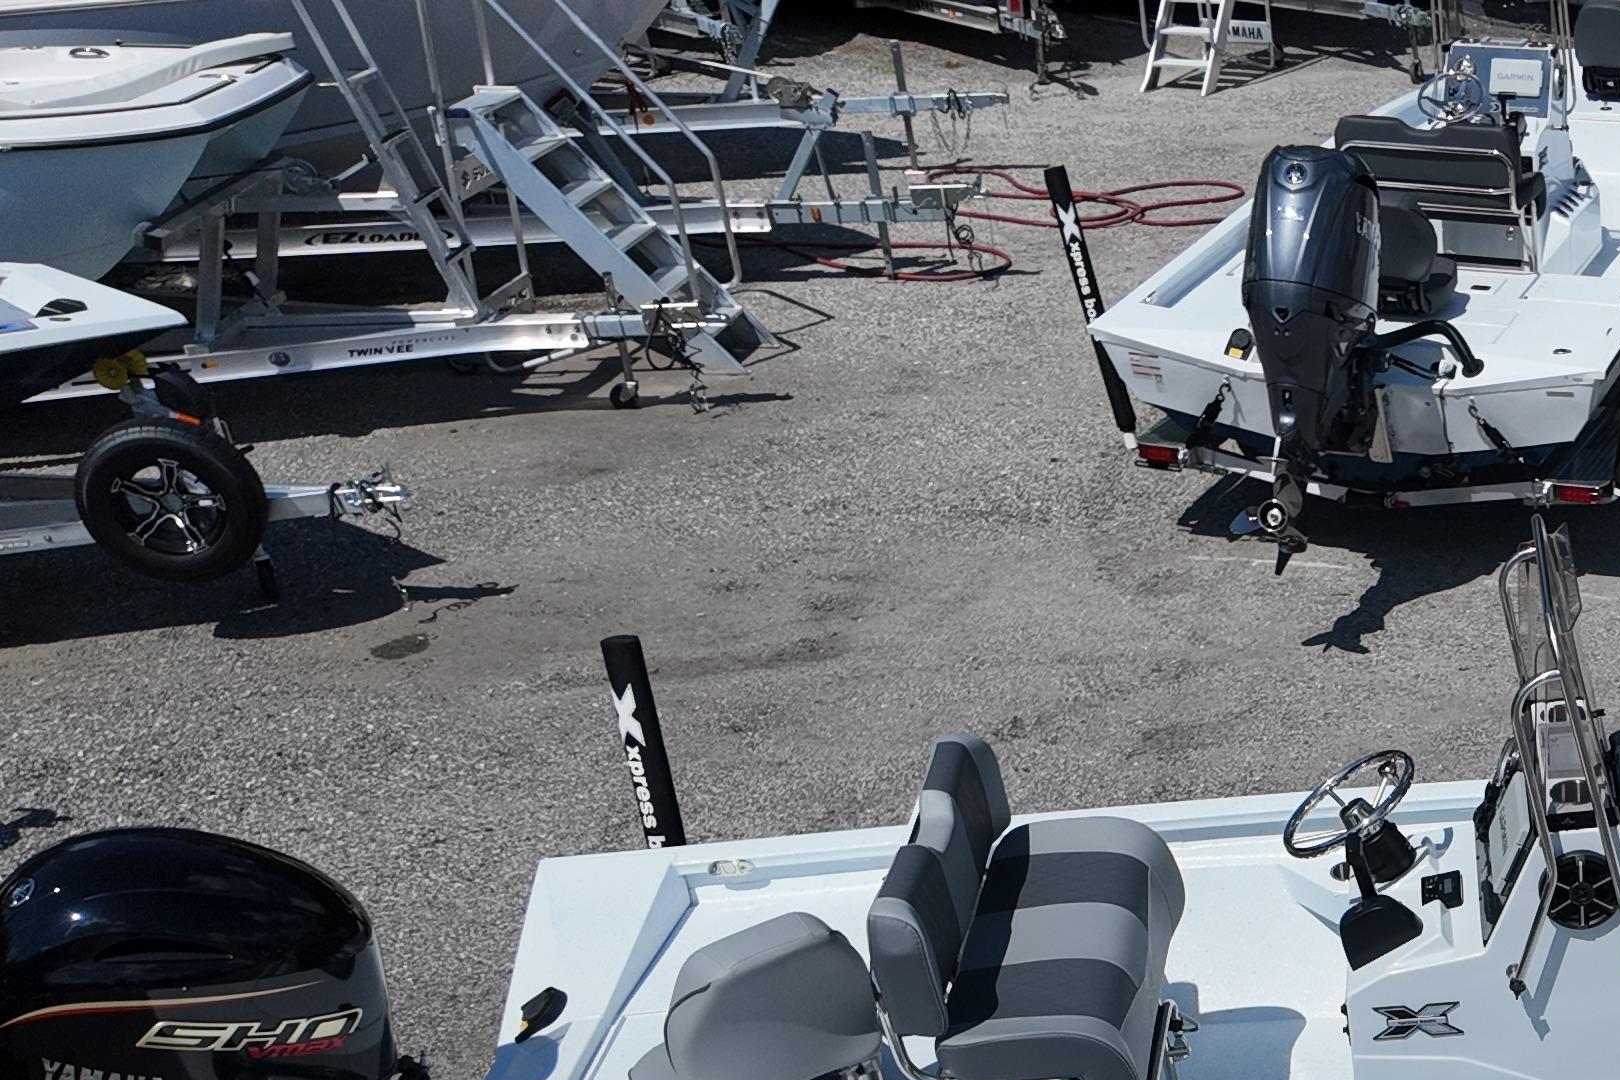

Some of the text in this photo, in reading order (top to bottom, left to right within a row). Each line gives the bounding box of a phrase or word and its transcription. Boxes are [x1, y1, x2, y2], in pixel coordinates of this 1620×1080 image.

[1496, 72, 1535, 81] GARMIN
[1070, 242, 1092, 295] xpress
[347, 344, 413, 357] TWIN VEE
[624, 745, 657, 829] xpress
[135, 1007, 364, 1051] SHO
